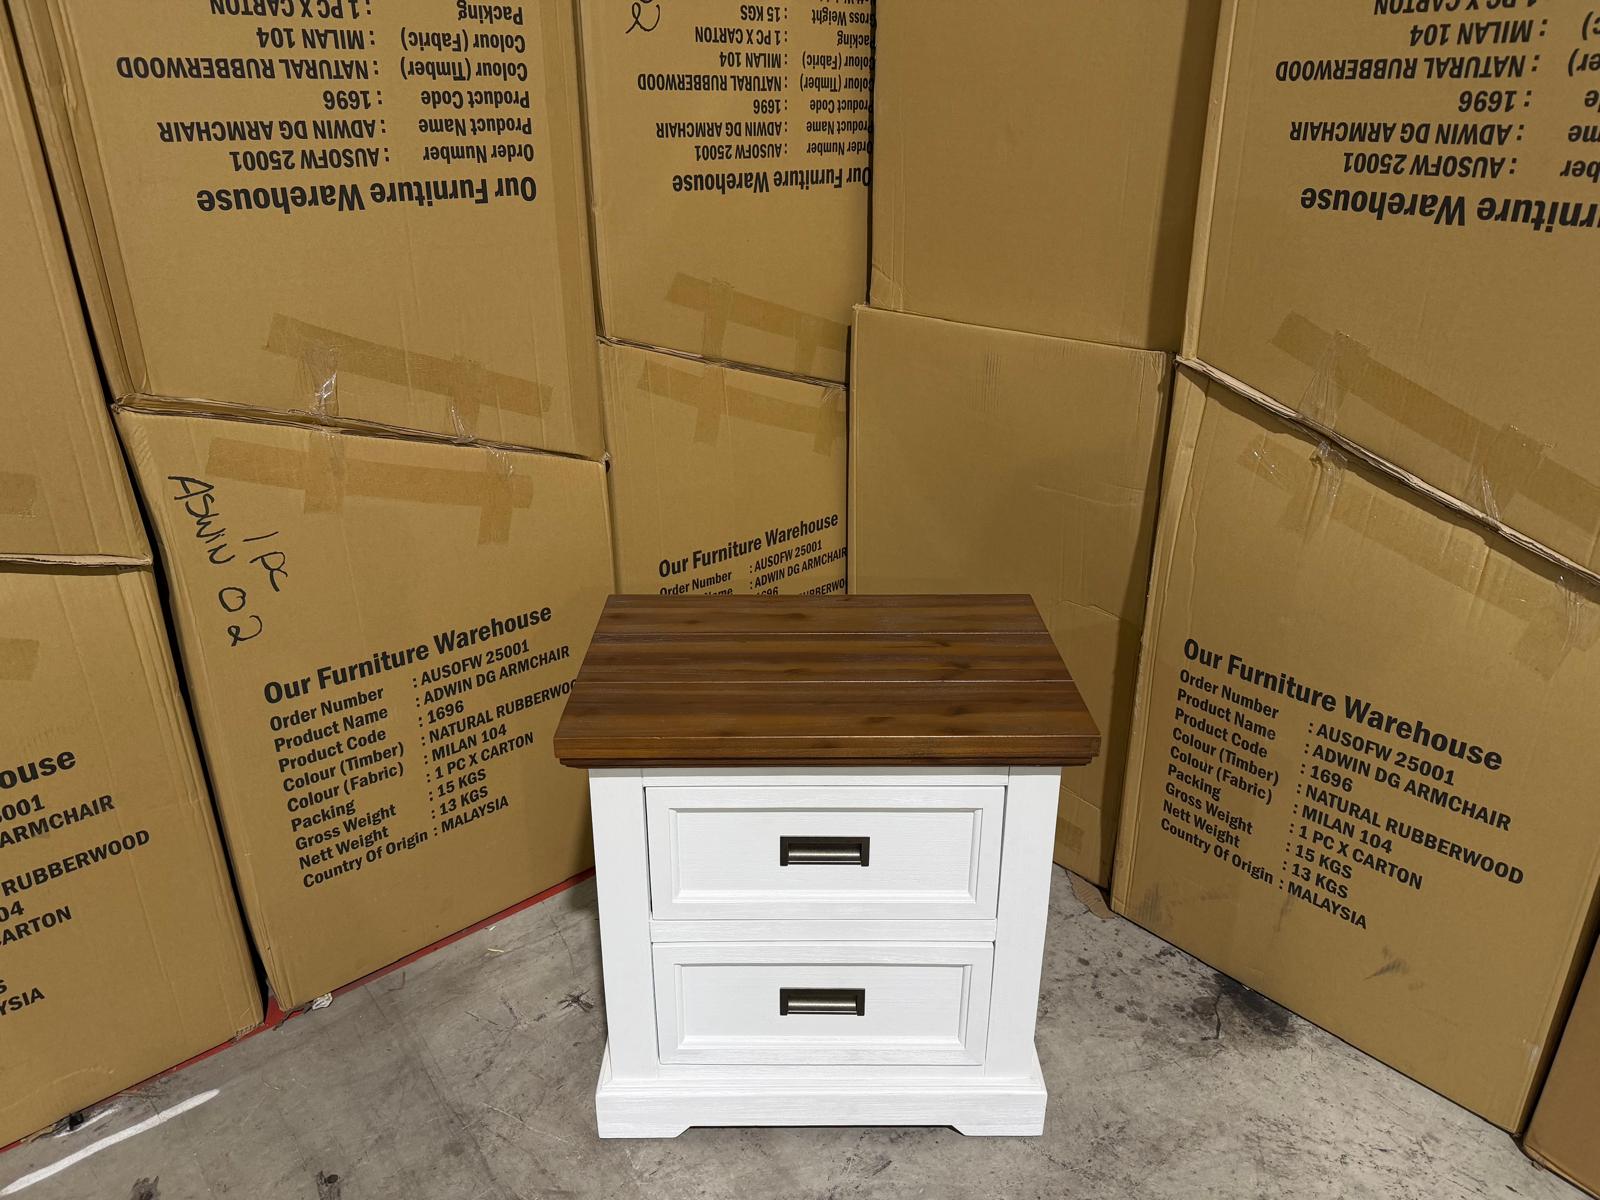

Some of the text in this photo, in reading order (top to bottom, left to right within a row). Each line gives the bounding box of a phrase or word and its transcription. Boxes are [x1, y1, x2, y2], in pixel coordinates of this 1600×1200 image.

[210, 0, 523, 25] Packing CARTON
[695, 26, 743, 44] CARTON
[740, 5, 847, 26] Weight 15 KGS
[1410, 20, 1533, 46] MILAN 104
[256, 27, 525, 53] Colour (Fabric) MILAN 104
[719, 51, 841, 70] (Fabric) MILAN 104
[117, 57, 527, 81] Colour (Timber) NATURAL RUBBERWOOD
[638, 73, 841, 92] (Timber) NATURAL RUBBERWOOD
[1276, 55, 1526, 81] NATURAL RUBBERWOOD
[323, 90, 530, 110] Product Code 1696
[753, 99, 835, 114] Code 1696
[1458, 91, 1517, 112] 1696
[157, 118, 532, 142] Product Name ADWIN DG ARMCHAIR
[656, 121, 834, 138] Name ADWIN DG ARMCHAIR
[694, 145, 733, 161] 25001
[735, 143, 782, 159] AUSOFW
[807, 142, 845, 156] Number
[1290, 122, 1513, 145] ADWIN DG ARMCHAIR
[229, 144, 534, 171] Order Number AUSOFW 25001
[673, 167, 872, 195] Our Furniture Warehouse
[1344, 153, 1506, 178] AUSOFW 25001
[197, 177, 536, 214] Our Furniture Warehouse
[1301, 188, 1600, 233] rniture Warehouse
[659, 514, 838, 578] Our Furniture Warehouse
[660, 583, 690, 595] Order
[692, 572, 732, 590] Number
[755, 549, 793, 572] AUSOFW
[794, 540, 822, 558] 25001
[755, 568, 785, 588] ADWIN
[787, 563, 800, 577] DG
[801, 547, 848, 572] ARMCHAIR
[264, 607, 551, 703] Our Furniture Warehouse
[270, 639, 529, 731] Order Number AUSOFW 25001
[274, 646, 569, 752] Product Name ADWIN DG ARMCHAIR
[1184, 639, 1502, 770] Our Furniture Warehouse
[279, 700, 464, 772] Product Code 1696
[283, 766, 336, 792] Colour
[340, 742, 403, 776] (Timber)
[429, 710, 493, 743] NATURAL
[1175, 707, 1353, 792] Product Code 1696
[1180, 669, 1454, 786] Order Number AUSOFW 25001
[288, 724, 507, 812] Colour (Fabric) MILAN 104
[291, 732, 533, 832] Packing PC CARTON
[1178, 688, 1511, 831] Product Name ADWIN DG ARMCHAIR
[0, 795, 115, 848] ARMCHAIR
[296, 769, 486, 850] Gross Weight 15 KGS
[1171, 746, 1392, 854] Colour (Fabric) MILAN 104
[1173, 728, 1523, 884] Colour (Timber) NATURAL RUBBERWOOD
[299, 786, 488, 869] Nett Weight 13 KGS
[304, 796, 508, 887] Country Of Origin MALAYSIA
[1163, 799, 1348, 898] Nett Weight 13 KGS
[1166, 782, 1352, 879] Gross Weight 15 KGS
[1168, 764, 1422, 889] Packing PC CARTON
[1, 830, 149, 896] RUBBERWOOD
[1161, 818, 1366, 929] Country Of Origin MALAYSIA
